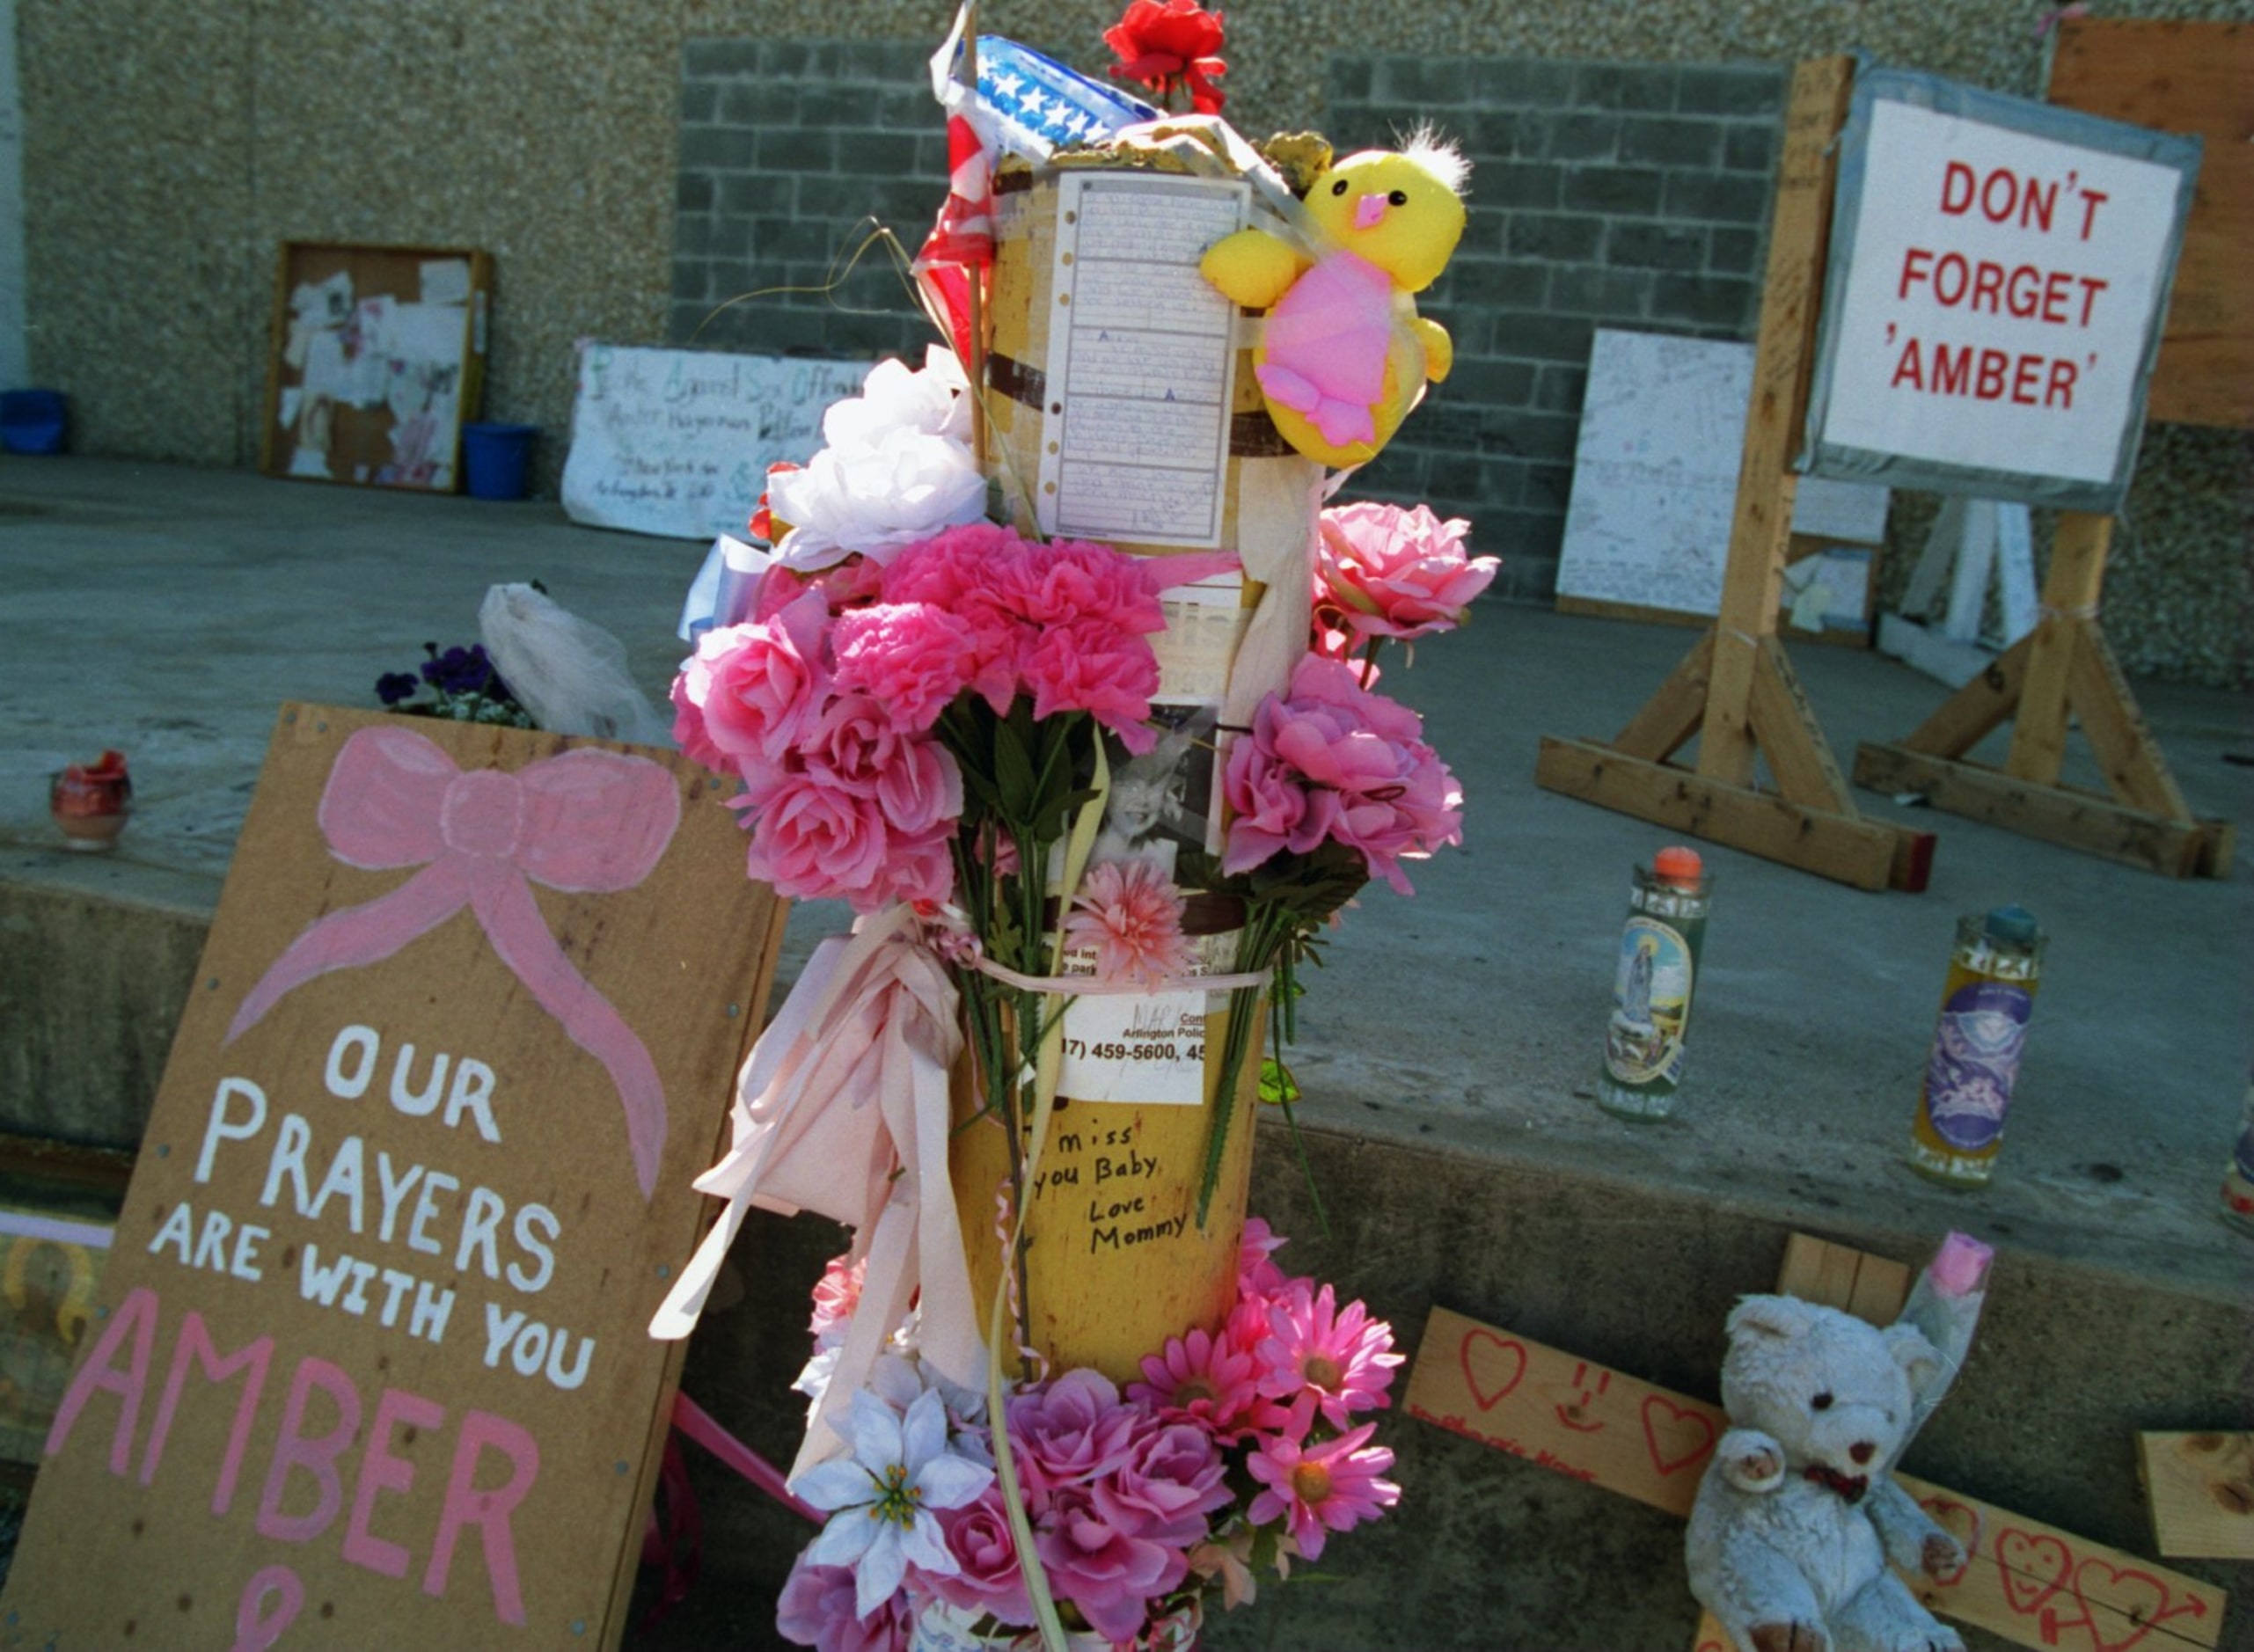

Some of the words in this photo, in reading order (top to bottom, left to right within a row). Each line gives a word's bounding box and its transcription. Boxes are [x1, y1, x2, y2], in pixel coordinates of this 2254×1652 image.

[1941, 160, 2108, 241] DON'T
[1898, 247, 2109, 327] FORGET
[1885, 322, 2097, 409] 'AMBER'
[1091, 1042, 1181, 1063] 459-5600,
[1123, 1027, 1175, 1041] Arlington
[324, 1024, 501, 1144] OUR
[194, 1076, 562, 1294] PRAYERS
[1034, 1166, 1079, 1200] you
[1095, 1149, 1158, 1185] Baby
[1088, 1196, 1145, 1223] Love
[1090, 1212, 1187, 1255] Mommy
[149, 1202, 271, 1282] ARE
[299, 1243, 456, 1344] WITH
[483, 1303, 596, 1390] YOU
[44, 1286, 540, 1627] AMBER
